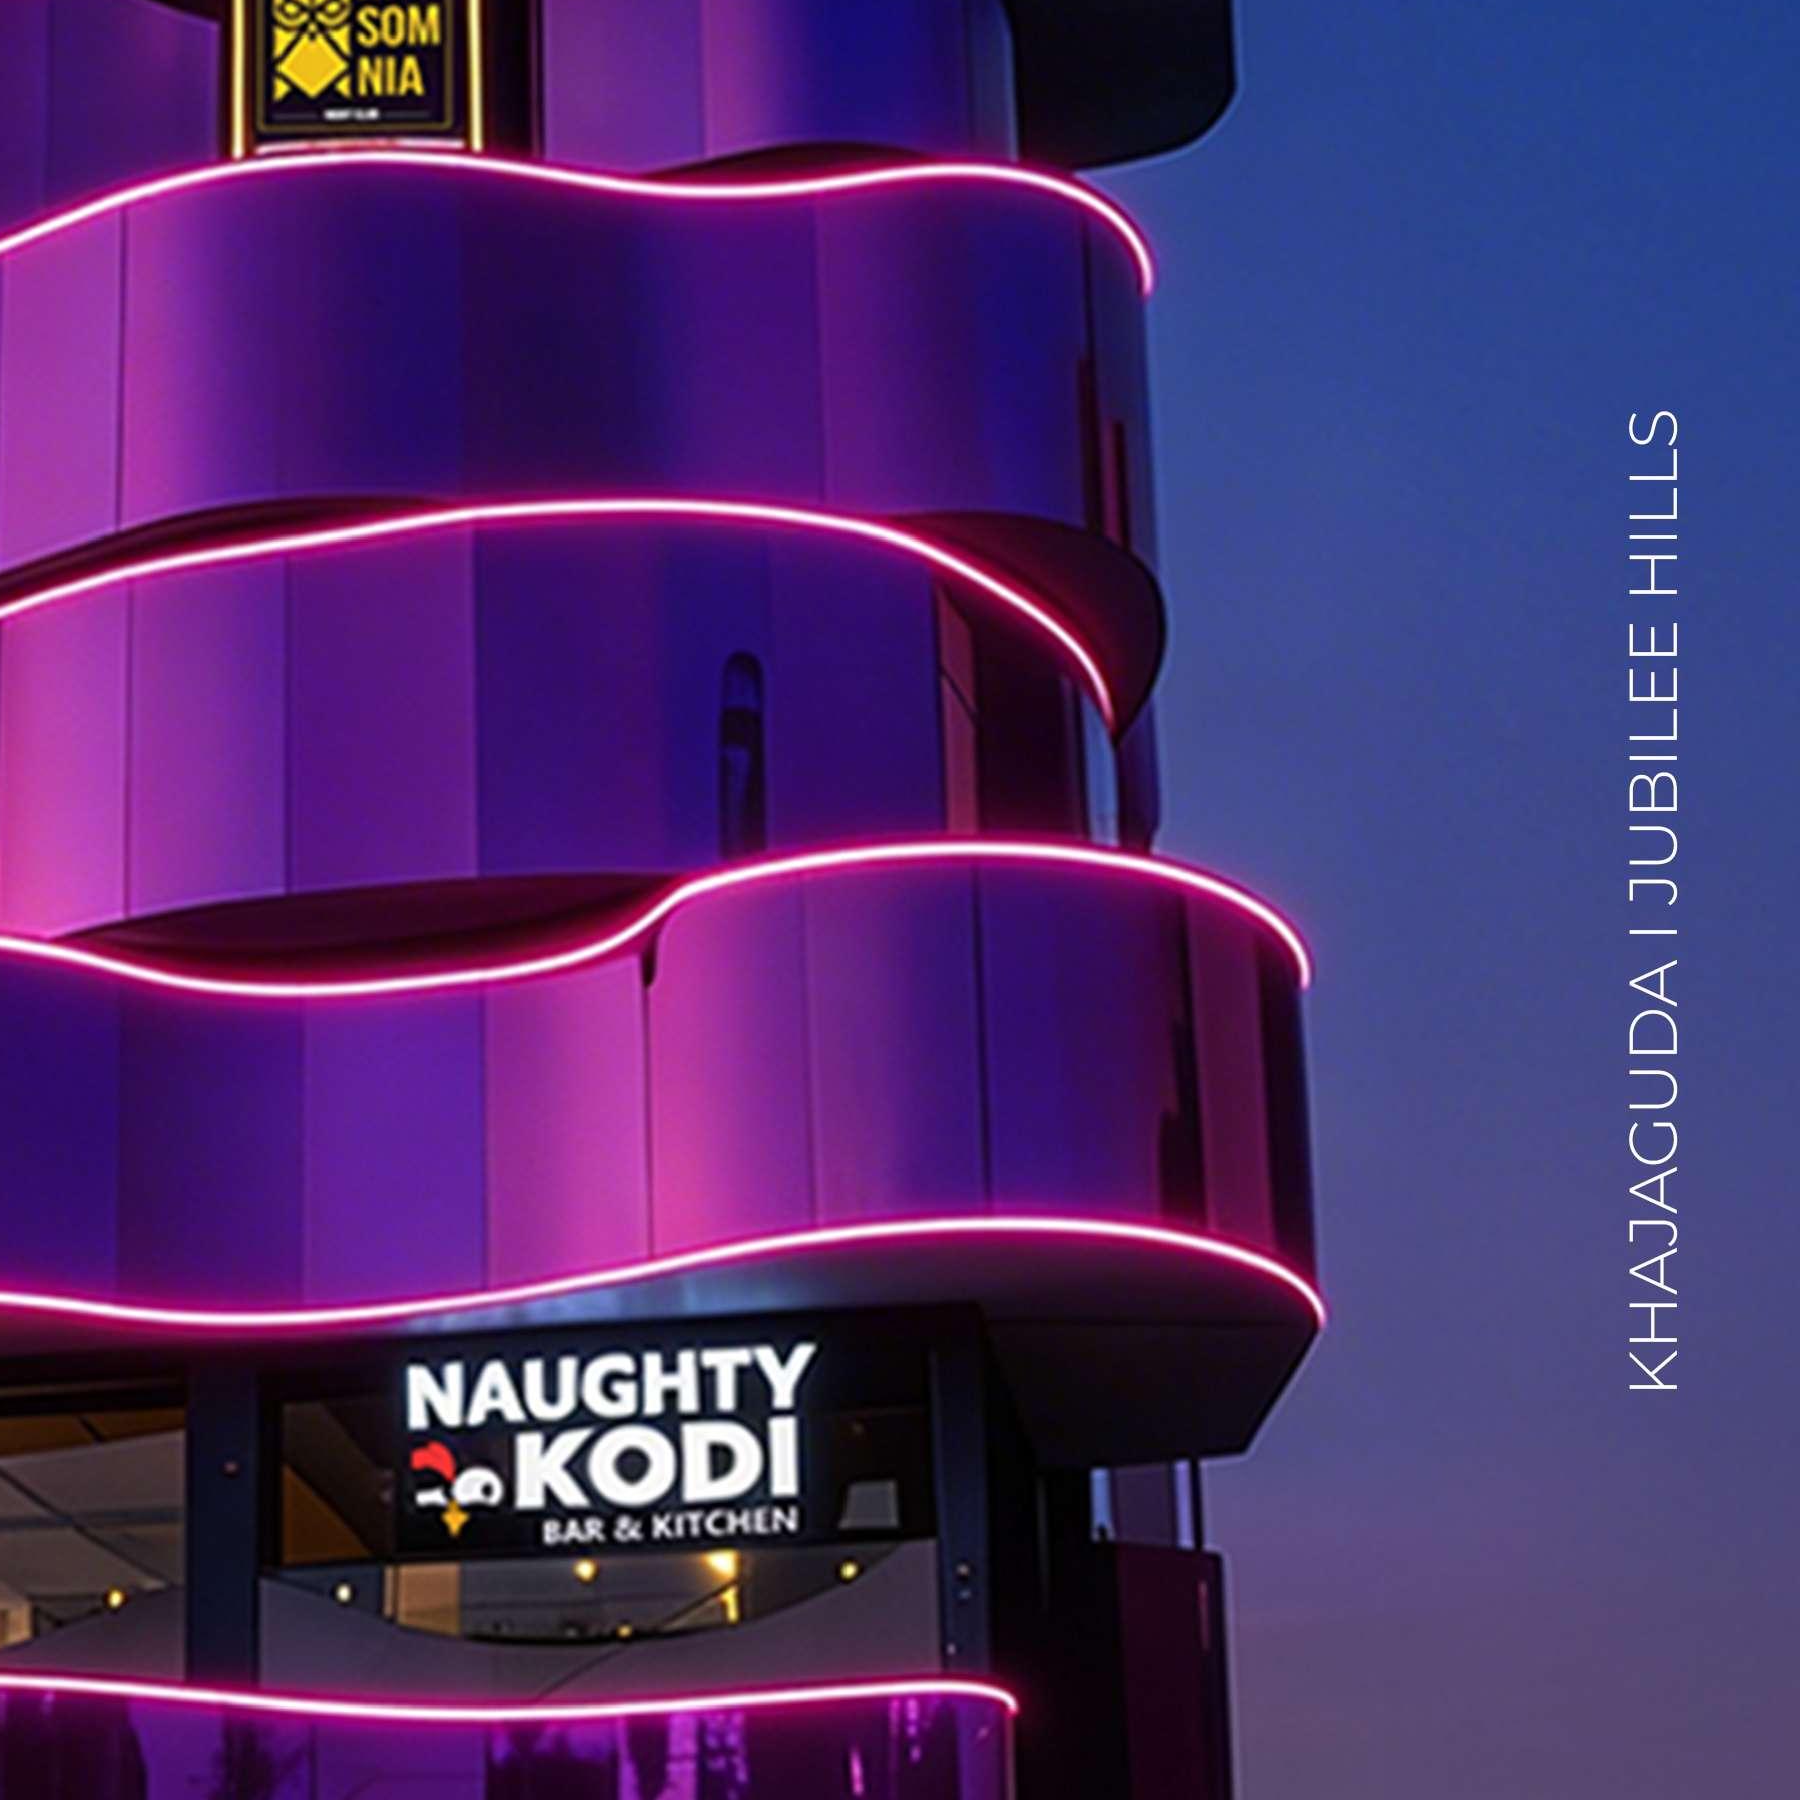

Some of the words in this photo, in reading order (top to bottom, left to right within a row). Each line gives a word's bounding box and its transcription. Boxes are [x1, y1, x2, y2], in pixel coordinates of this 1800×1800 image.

[356, 4, 441, 47] SOM
[357, 55, 425, 97] NIA
[406, 1342, 816, 1430] NAUGHTY
[514, 1415, 799, 1510] KODI
[542, 1518, 604, 1545] BAR
[613, 1513, 643, 1542] &
[652, 1506, 800, 1540] KITCHEN
